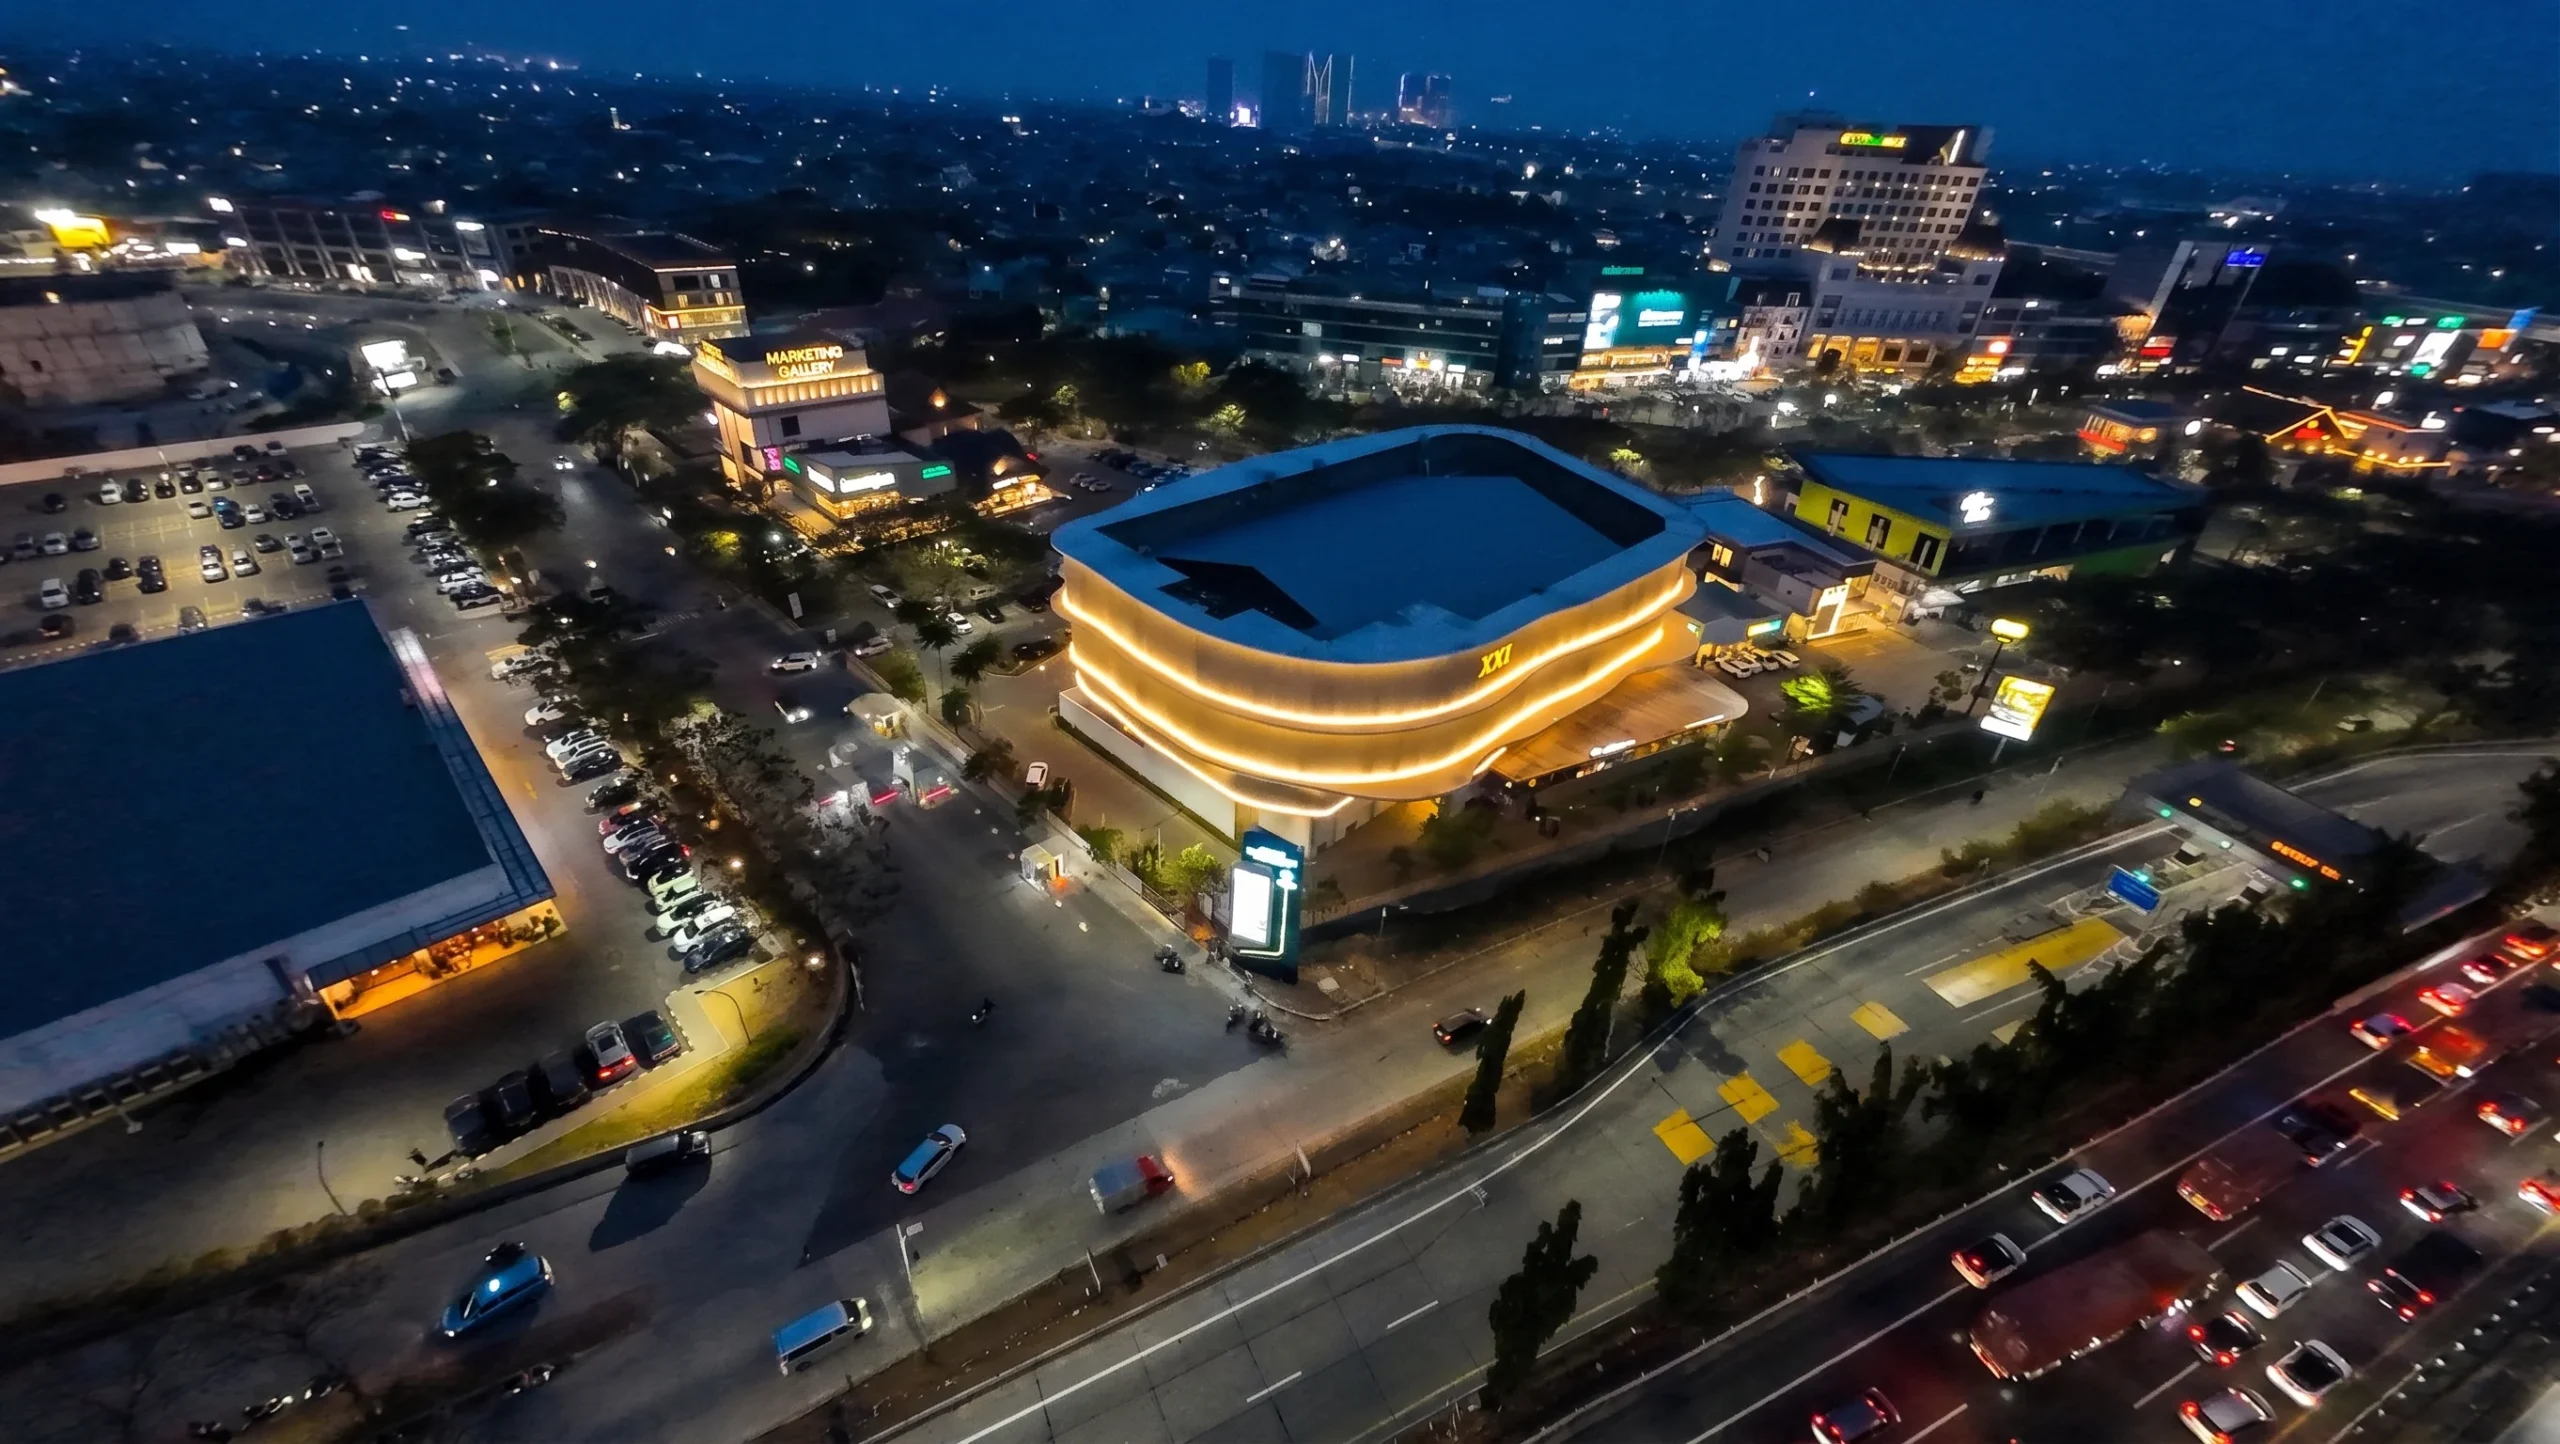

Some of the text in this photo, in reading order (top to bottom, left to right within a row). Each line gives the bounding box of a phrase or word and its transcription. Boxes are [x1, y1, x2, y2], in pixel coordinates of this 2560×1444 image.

[766, 345, 843, 366] MARKETING
[778, 361, 835, 379] GALLERY
[1478, 643, 1512, 678] XXI
